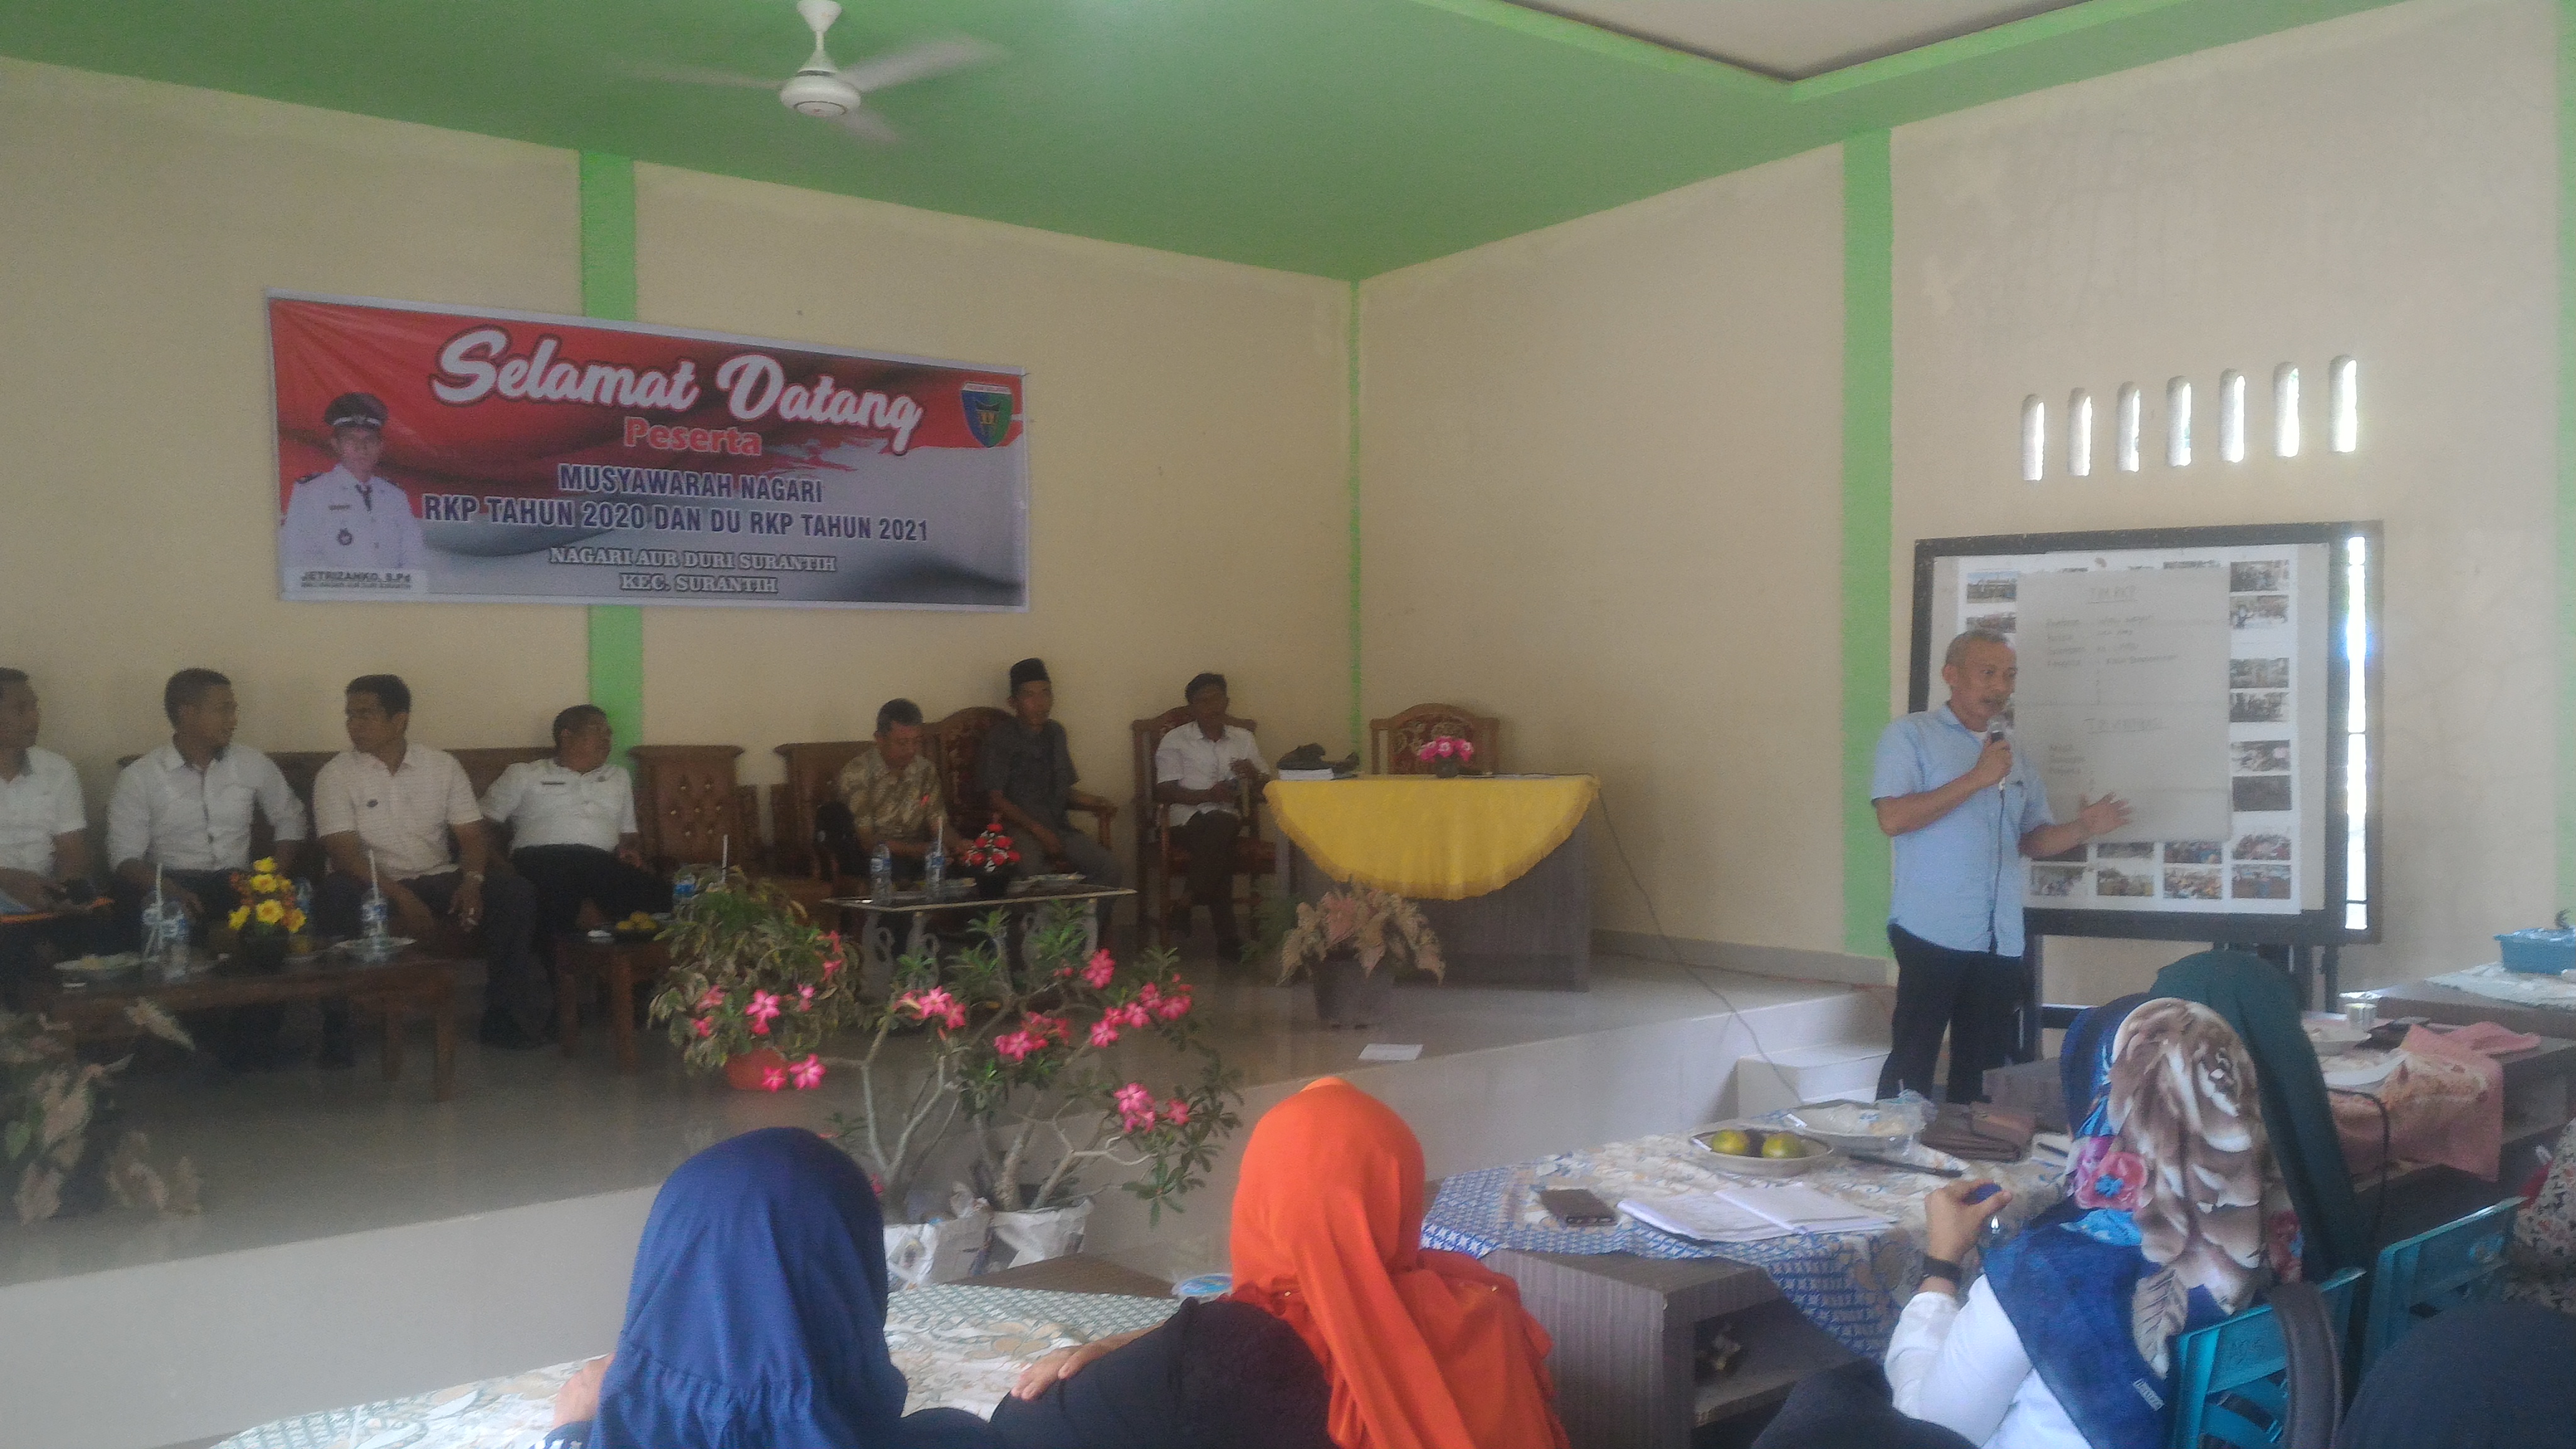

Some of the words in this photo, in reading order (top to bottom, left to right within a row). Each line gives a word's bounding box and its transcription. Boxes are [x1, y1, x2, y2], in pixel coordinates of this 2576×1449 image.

[430, 327, 702, 411] Selamat
[716, 354, 924, 455] Datang
[624, 416, 762, 456] Peserta
[558, 464, 732, 498] MUSYAWARAH
[740, 474, 822, 503] NAGARI
[423, 494, 477, 523] RKP
[485, 496, 575, 527] TAHUN
[582, 501, 645, 530] 2020
[654, 505, 701, 532] DAN
[710, 508, 741, 533] DU
[750, 509, 793, 536] RKP
[800, 513, 872, 539] TAHUN
[878, 517, 928, 541] 2021
[550, 546, 633, 565] NAGARI
[635, 548, 678, 567] AUR
[684, 550, 735, 569] DURI
[738, 552, 836, 572] SURANTIH
[619, 572, 670, 591] KEC.
[675, 574, 779, 594] SURANTIH
